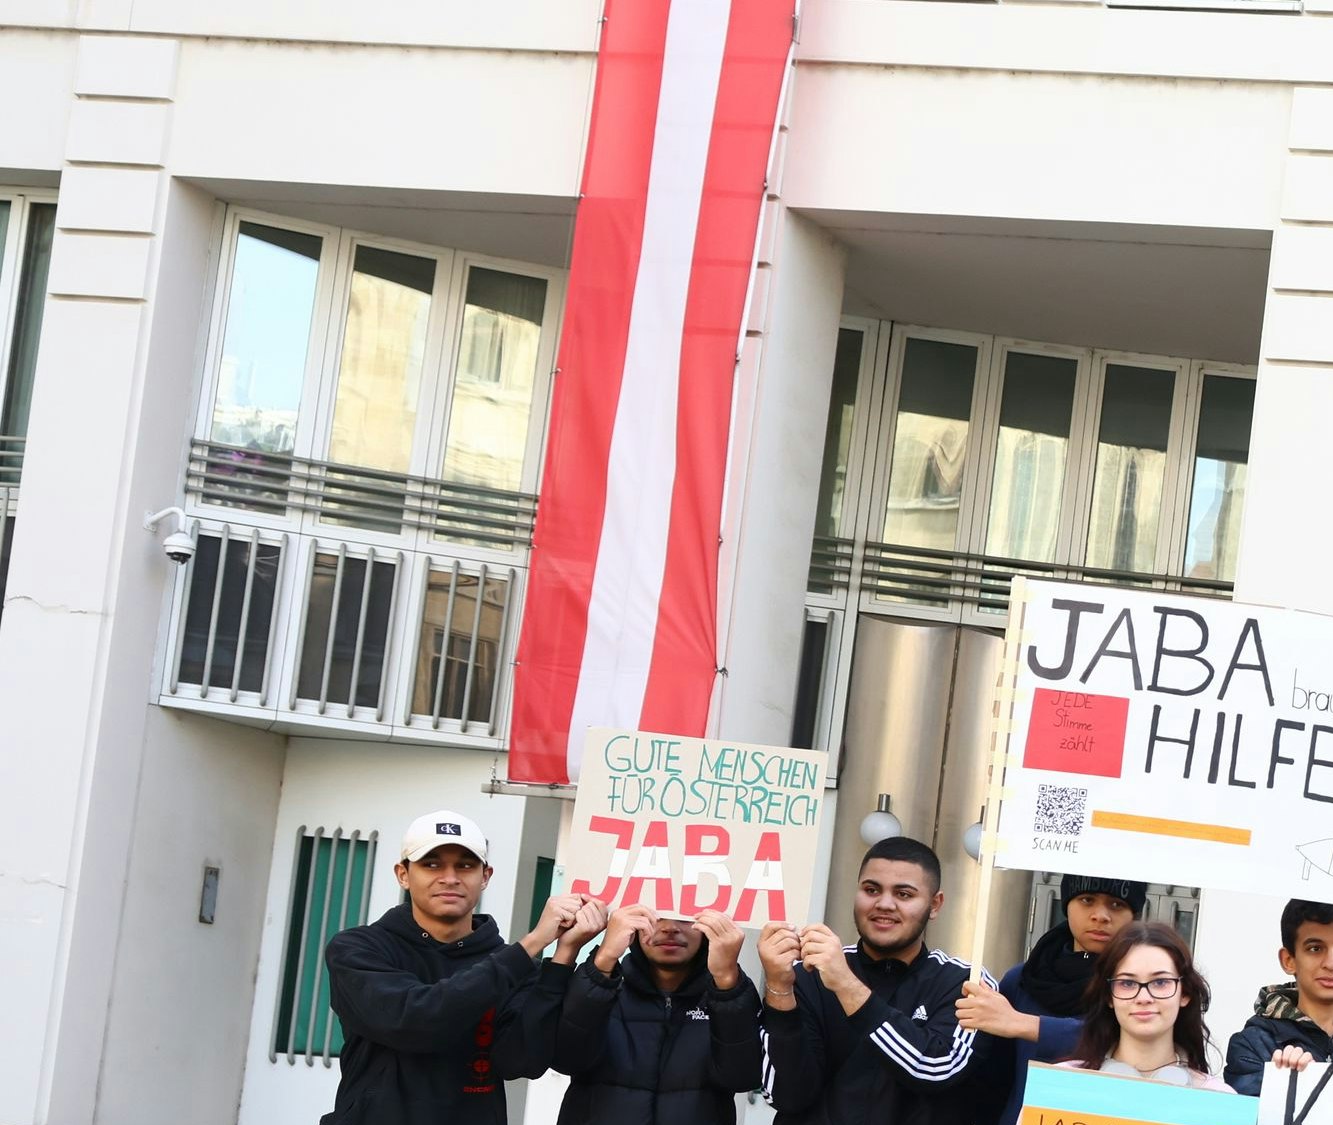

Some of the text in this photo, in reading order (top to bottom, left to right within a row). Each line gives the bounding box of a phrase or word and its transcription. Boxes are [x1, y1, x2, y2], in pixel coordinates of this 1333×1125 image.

[1027, 598, 1275, 706] JABA
[1051, 691, 1095, 710] JEDE
[1053, 709, 1093, 731] Stimme
[604, 735, 818, 790] GUTE MENSCHEN
[1059, 736, 1096, 753] zählt
[659, 774, 818, 826] ÖSTERREICH
[1032, 837, 1079, 854] SCAN ME
[570, 815, 787, 922] JABA
